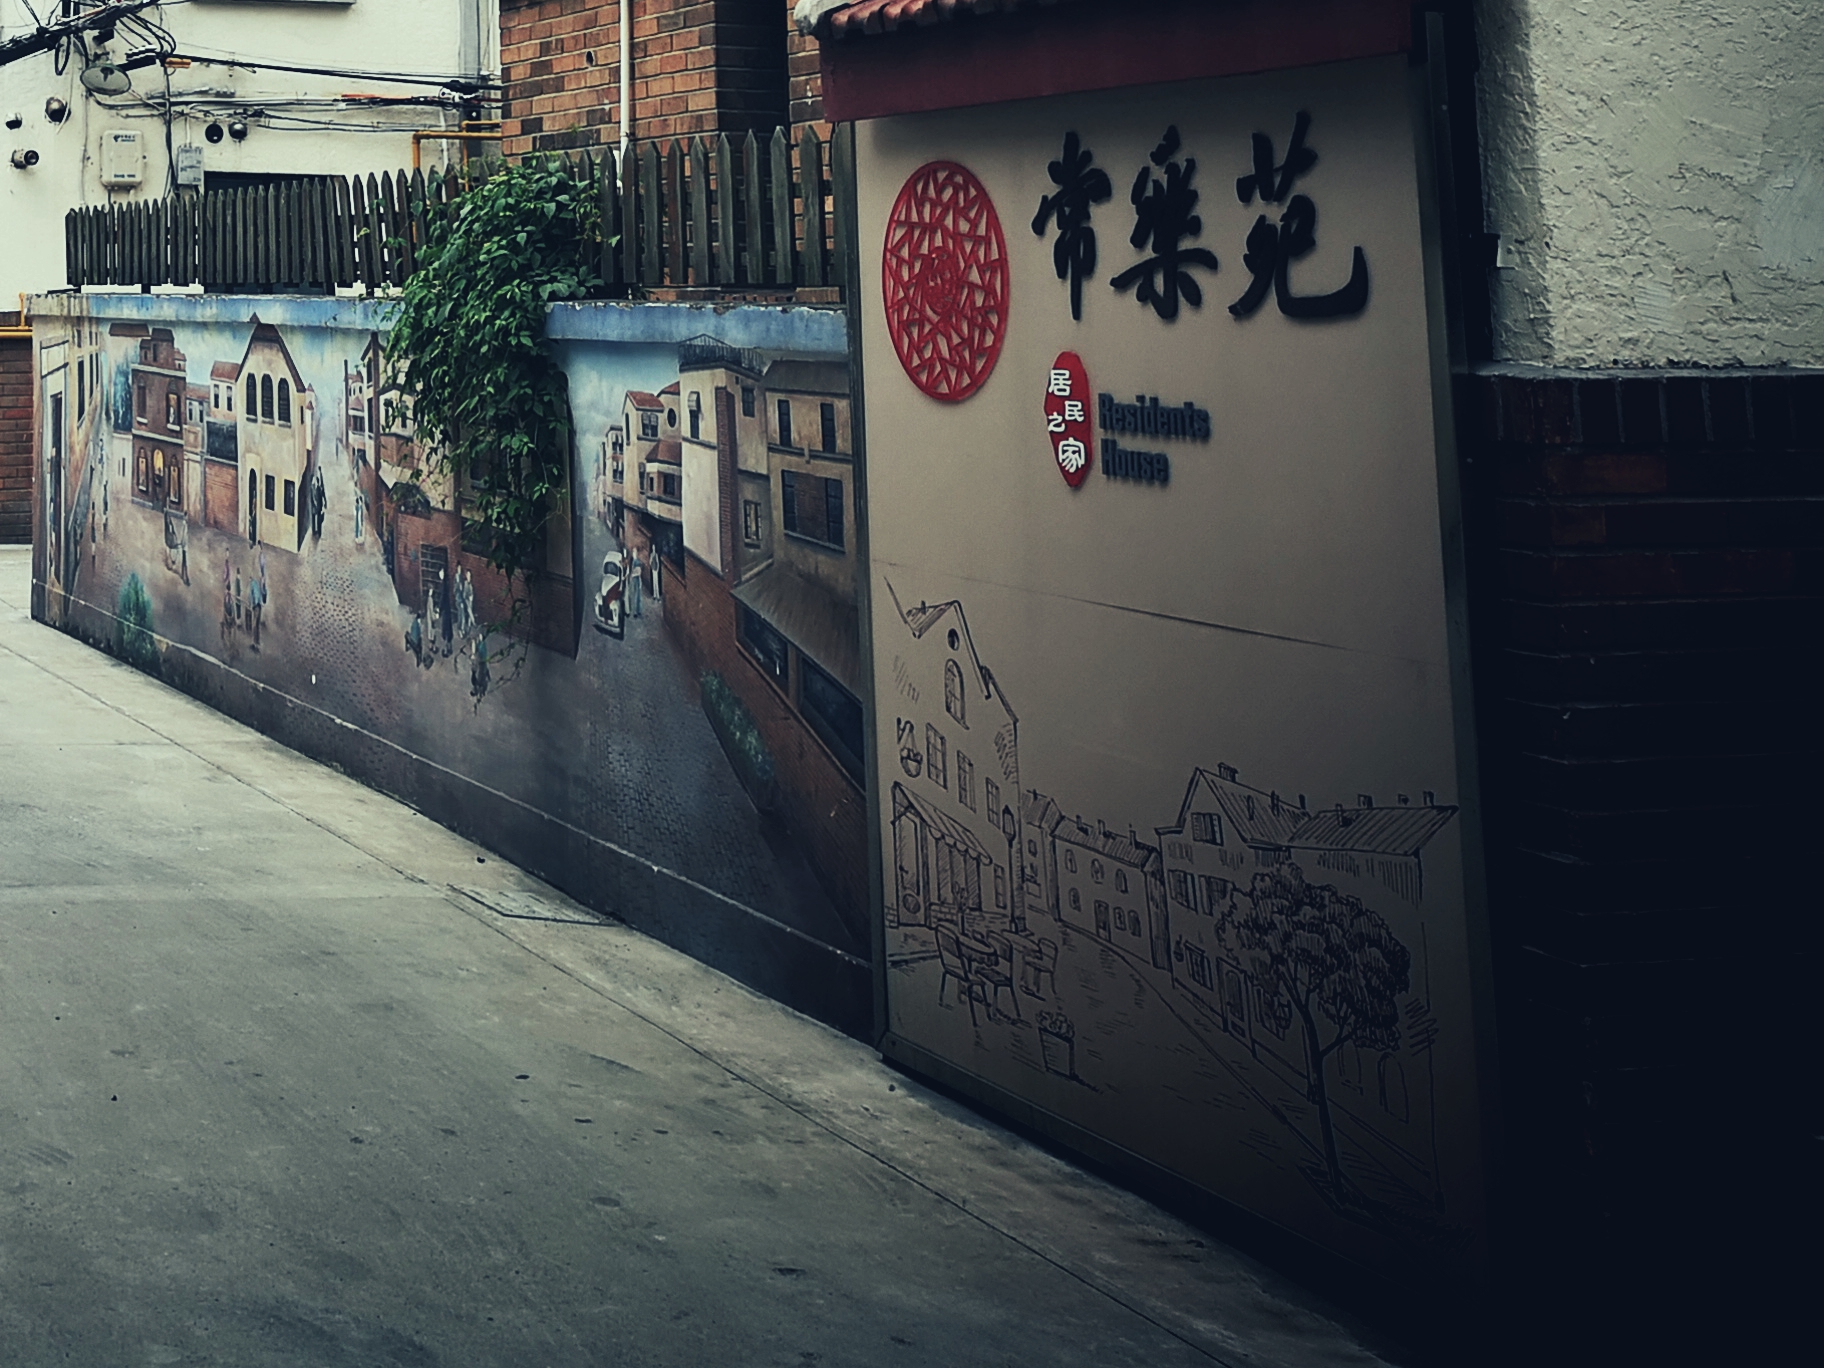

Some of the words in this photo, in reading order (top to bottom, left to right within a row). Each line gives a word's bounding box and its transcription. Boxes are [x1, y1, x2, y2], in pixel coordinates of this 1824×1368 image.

[1048, 369, 1086, 473] 居民之家
[1098, 392, 1211, 440] Residents
[1100, 438, 1170, 482] House
